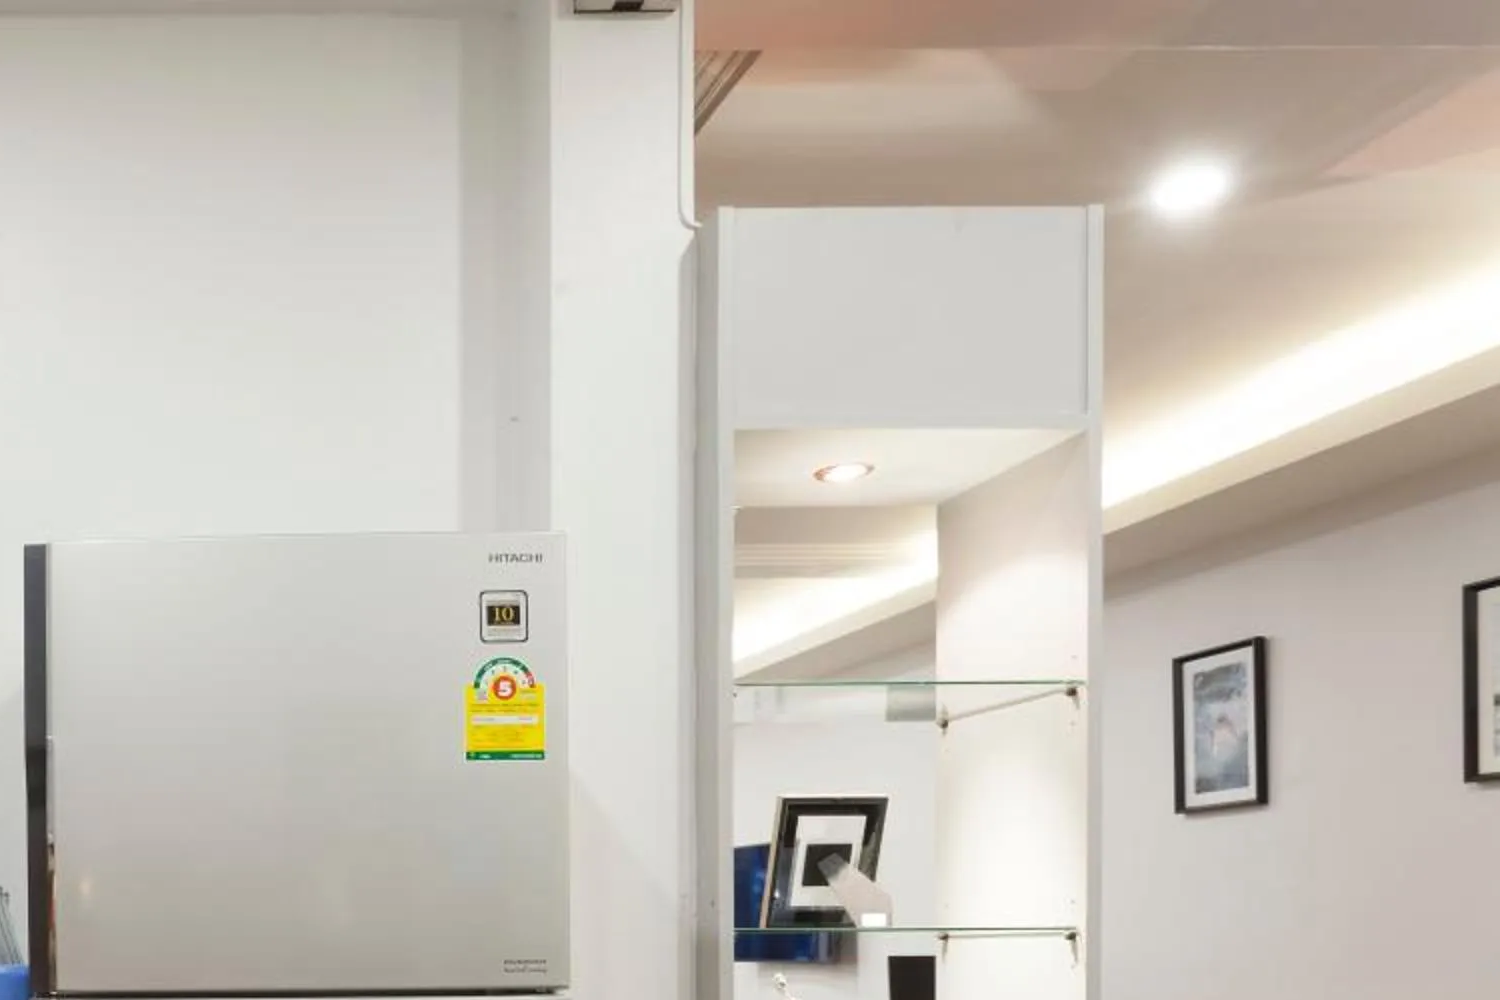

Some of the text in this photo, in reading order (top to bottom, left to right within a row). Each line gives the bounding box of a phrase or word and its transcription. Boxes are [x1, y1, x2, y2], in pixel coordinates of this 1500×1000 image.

[489, 553, 542, 562] HITACHI
[494, 606, 515, 621] 10
[498, 681, 512, 696] 5
